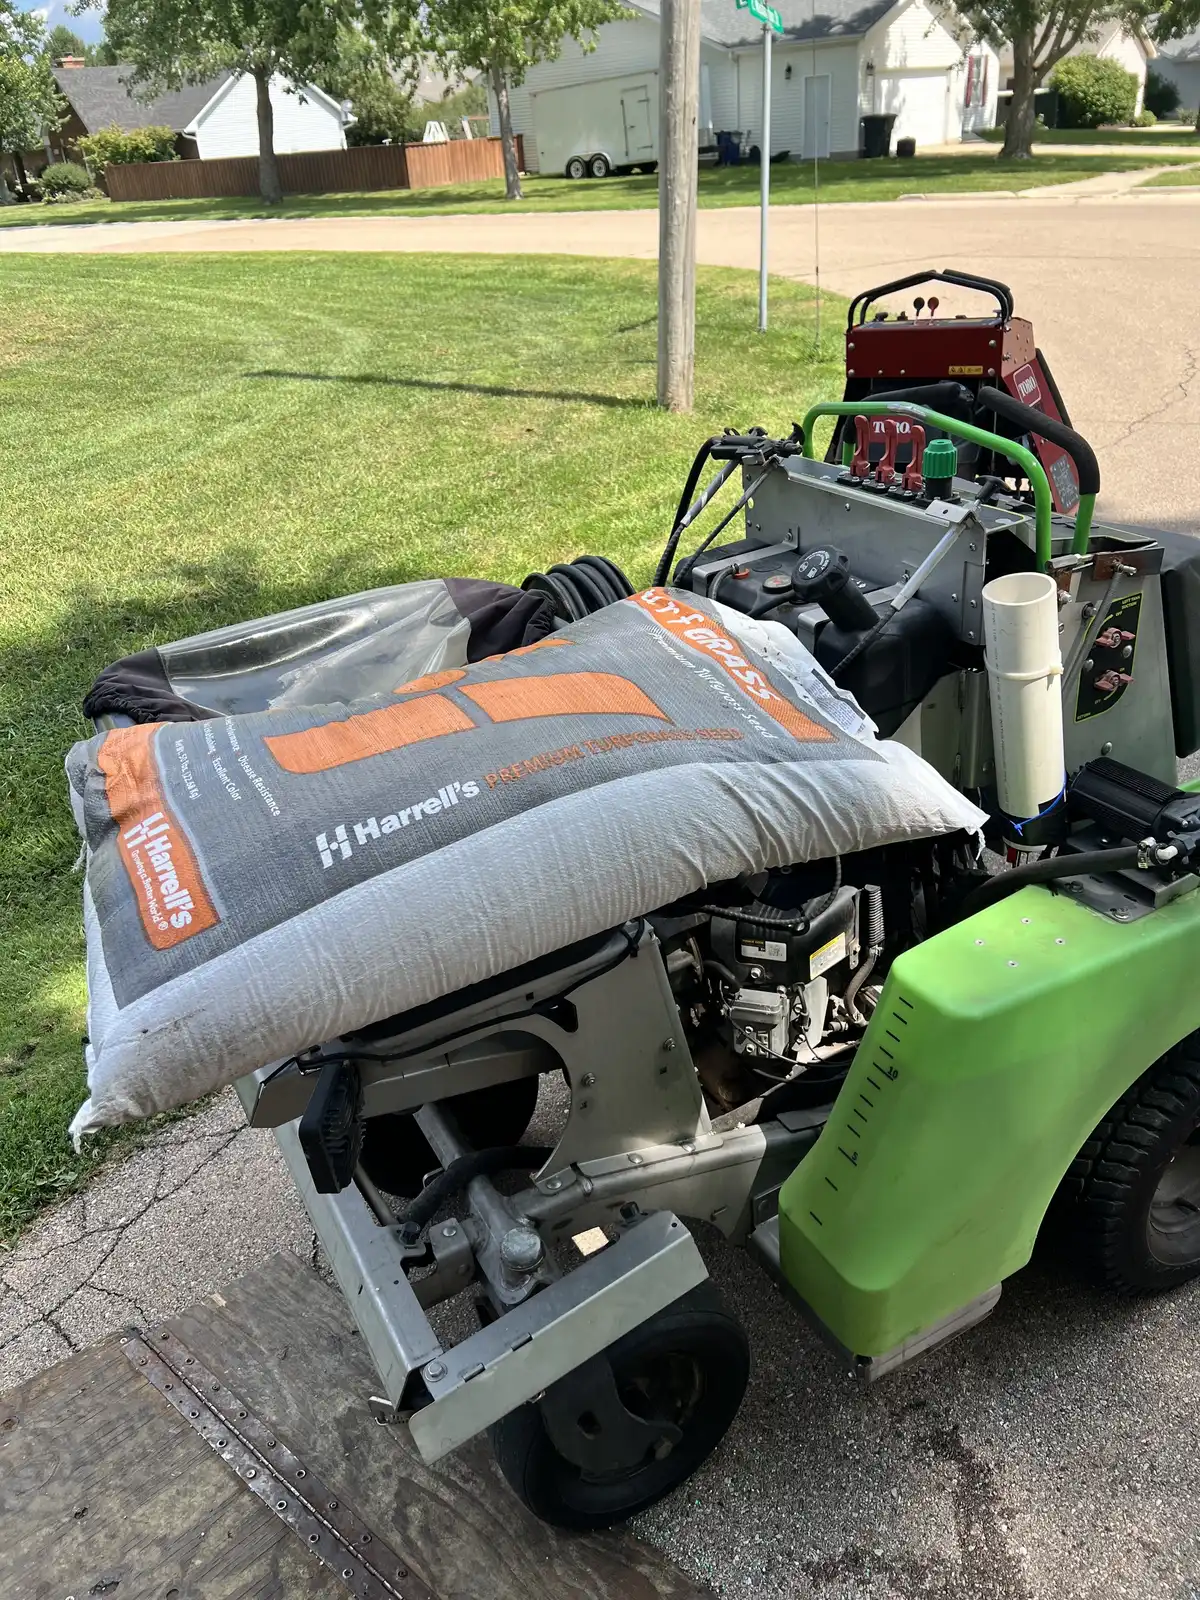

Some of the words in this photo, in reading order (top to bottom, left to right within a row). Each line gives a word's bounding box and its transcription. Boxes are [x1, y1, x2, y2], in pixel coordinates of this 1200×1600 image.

[1018, 376, 1036, 397] TORO
[641, 588, 782, 701] urfGRASS
[648, 632, 696, 668] Premium
[693, 668, 744, 711] Turfgrass
[742, 713, 778, 738] Seed
[212, 756, 231, 784] Excellent
[225, 782, 242, 801] Color
[238, 755, 257, 780] Disease
[252, 777, 280, 816] Resistance
[353, 780, 480, 846] Harrell's
[483, 743, 585, 791] PREMIUM
[583, 728, 696, 754] TURFGRASS
[695, 728, 743, 740] SEED
[131, 849, 145, 875] Growing
[142, 877, 153, 900] Better
[144, 835, 196, 929] Harrell's
[887, 1066, 898, 1080] 10
[851, 1152, 859, 1162] 5
